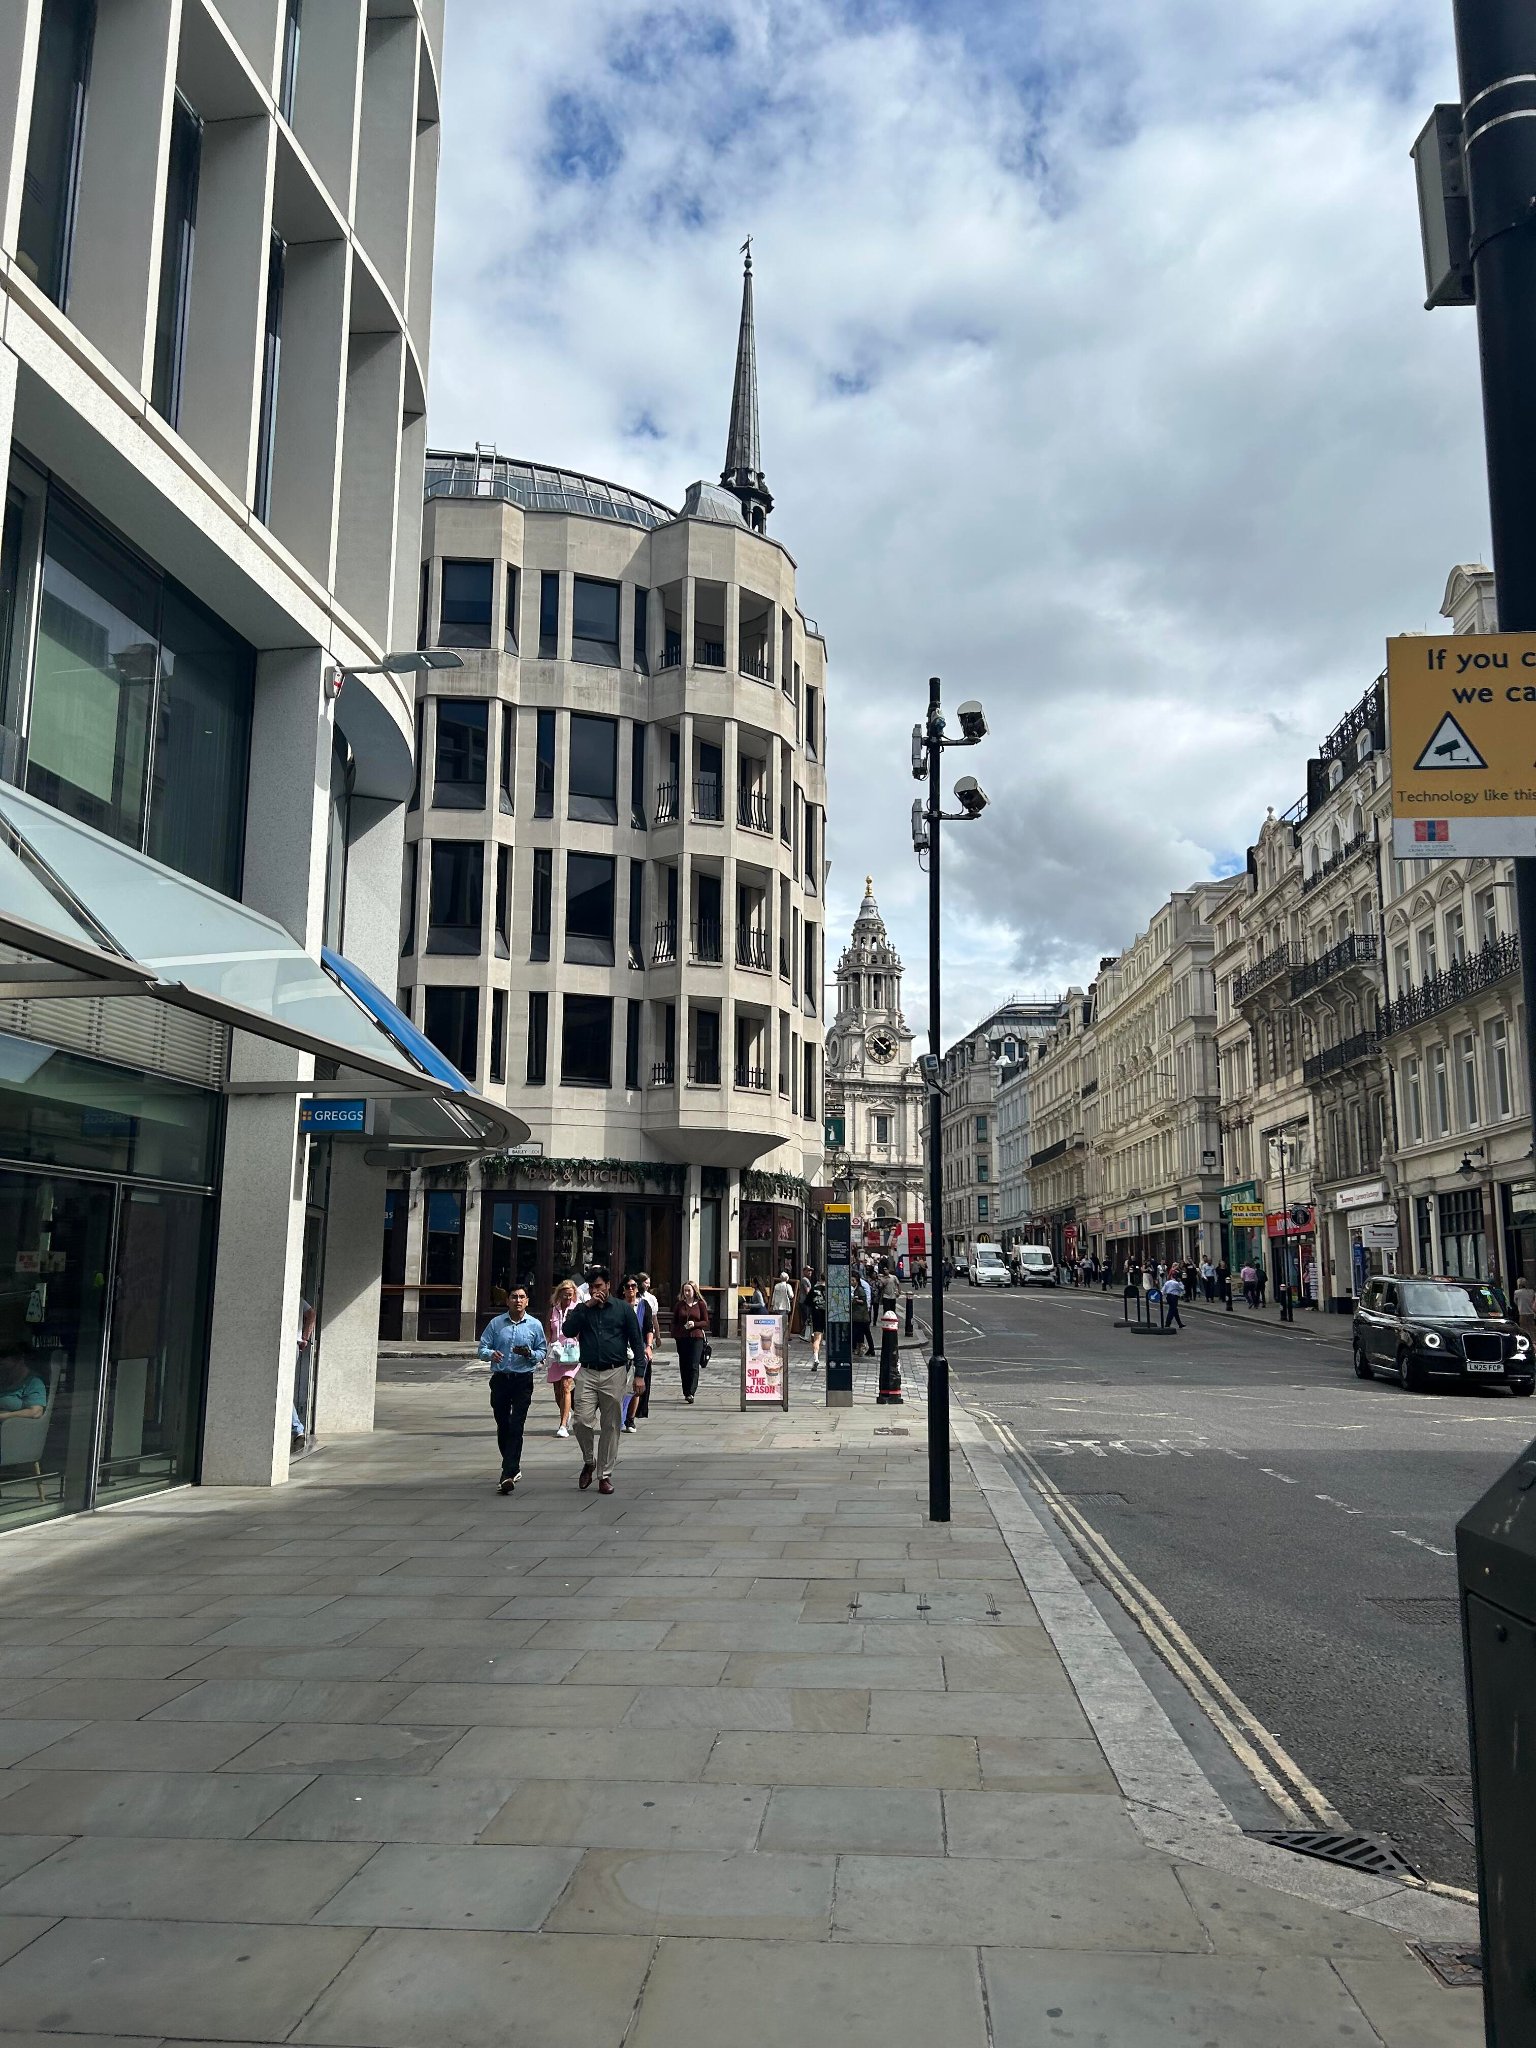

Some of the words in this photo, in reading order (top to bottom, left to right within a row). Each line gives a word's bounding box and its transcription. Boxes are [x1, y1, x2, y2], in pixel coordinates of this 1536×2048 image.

[1428, 648, 1447, 670] If
[1456, 651, 1509, 673] you
[1452, 686, 1493, 703] we
[1505, 686, 1536, 702] ca
[1397, 790, 1479, 804] Technology
[1484, 789, 1510, 801] like
[314, 1110, 364, 1121] GREGGS
[528, 1167, 557, 1180] BAR
[562, 1167, 575, 1181] &
[578, 1169, 637, 1183] KITCHEN
[747, 1368, 760, 1377] SIP
[745, 1385, 775, 1394] SEASON
